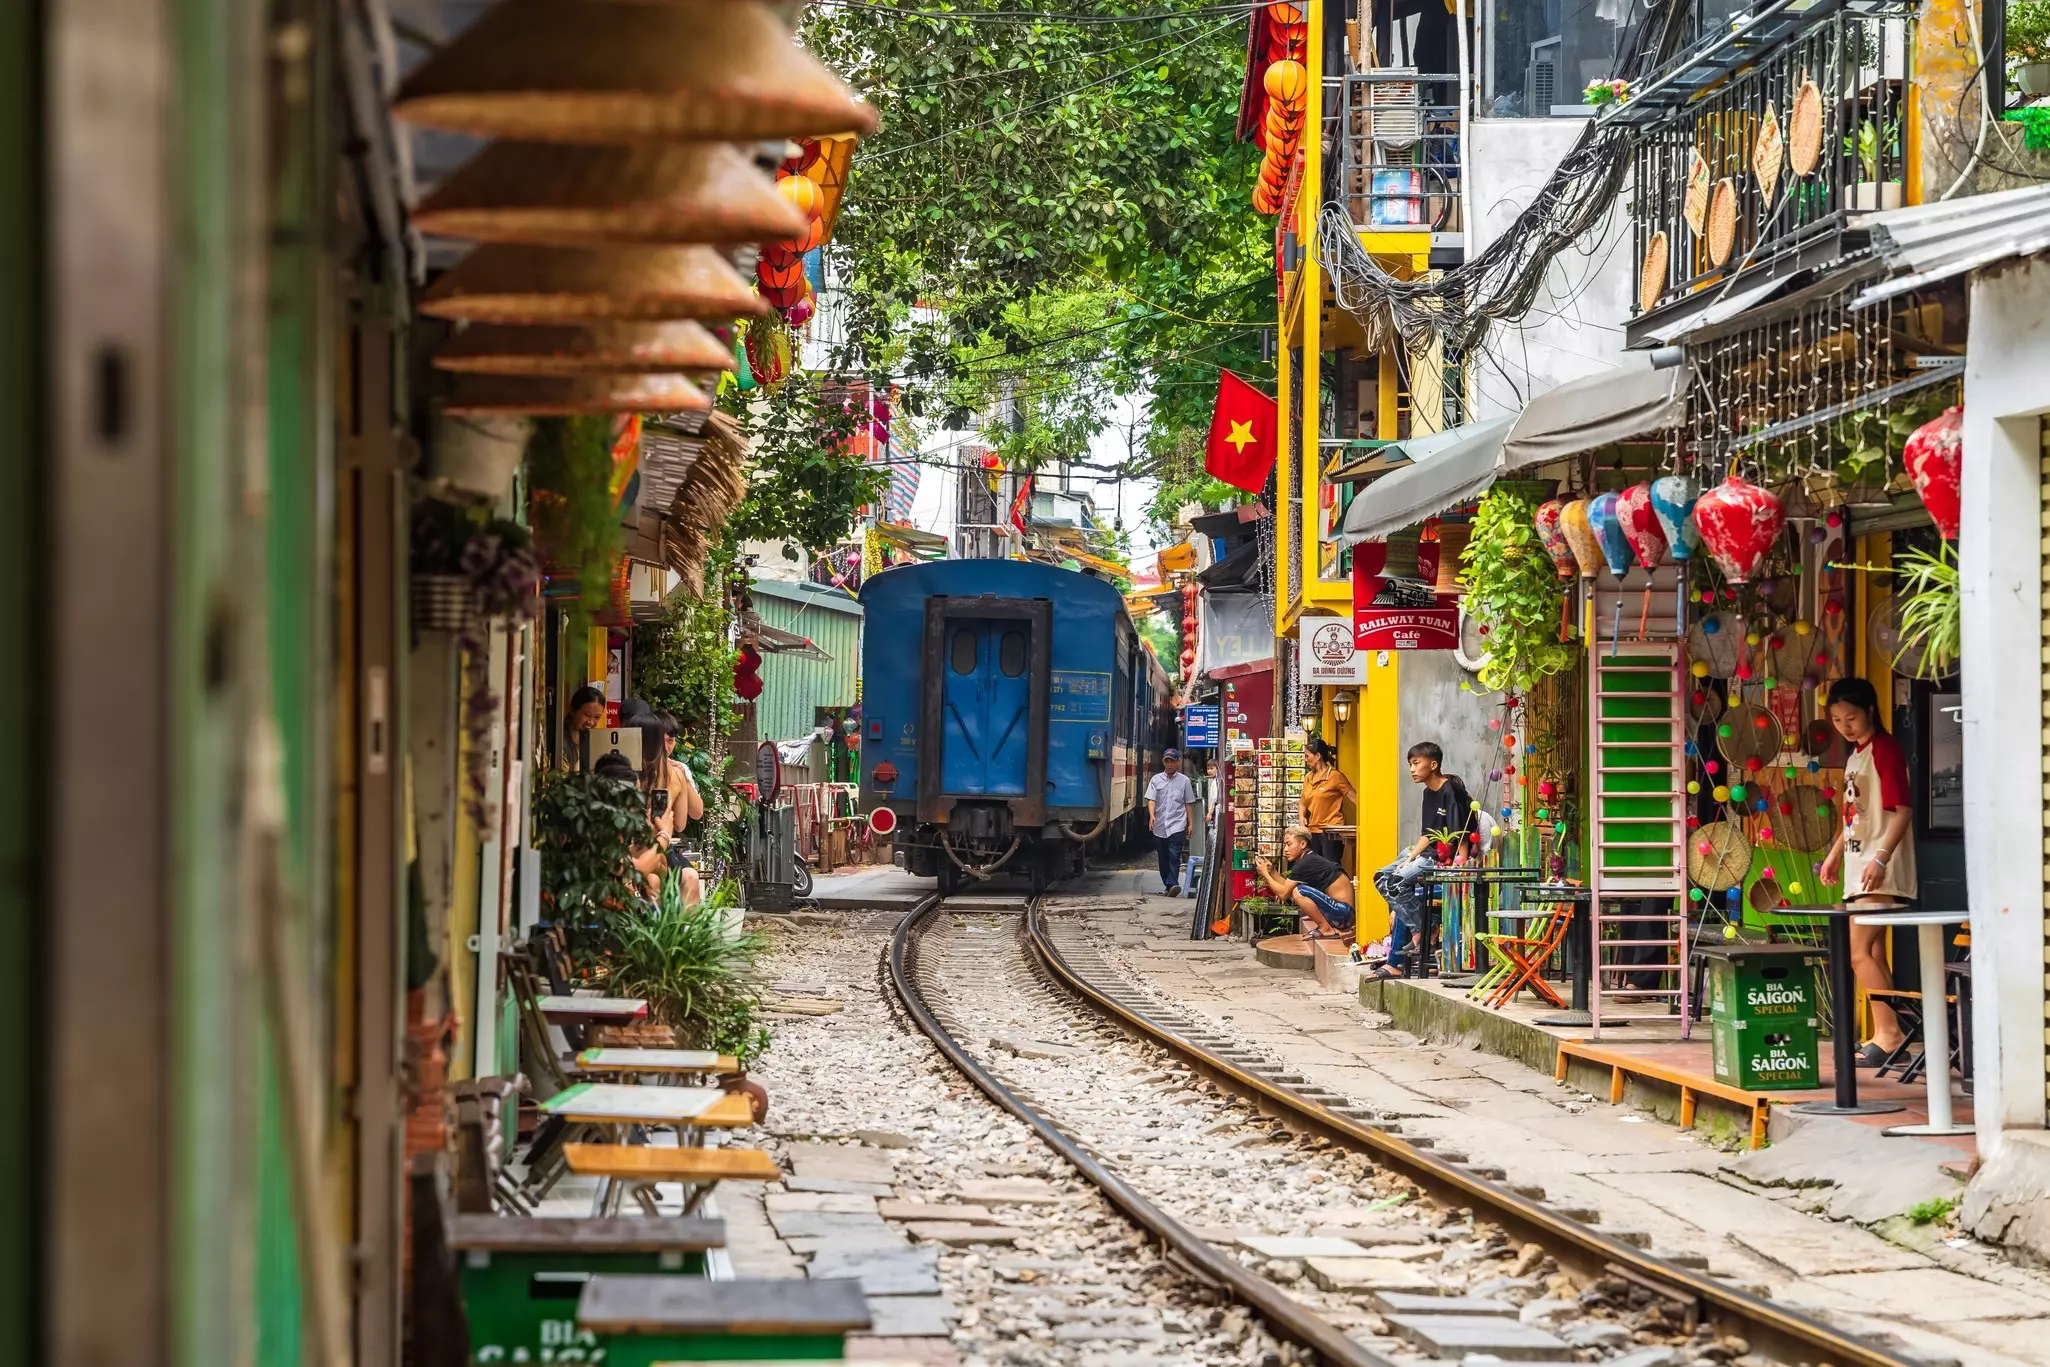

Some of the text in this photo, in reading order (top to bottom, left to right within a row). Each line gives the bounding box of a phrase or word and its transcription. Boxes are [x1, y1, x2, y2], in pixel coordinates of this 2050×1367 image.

[1358, 615, 1451, 632] RAILWAY TUAN
[1392, 630, 1420, 639] Café
[1766, 983, 1784, 991] BIA
[1754, 1005, 1799, 1015] SPECIAL
[1769, 1049, 1787, 1057] BIA
[1758, 1071, 1802, 1081] SPECIAL
